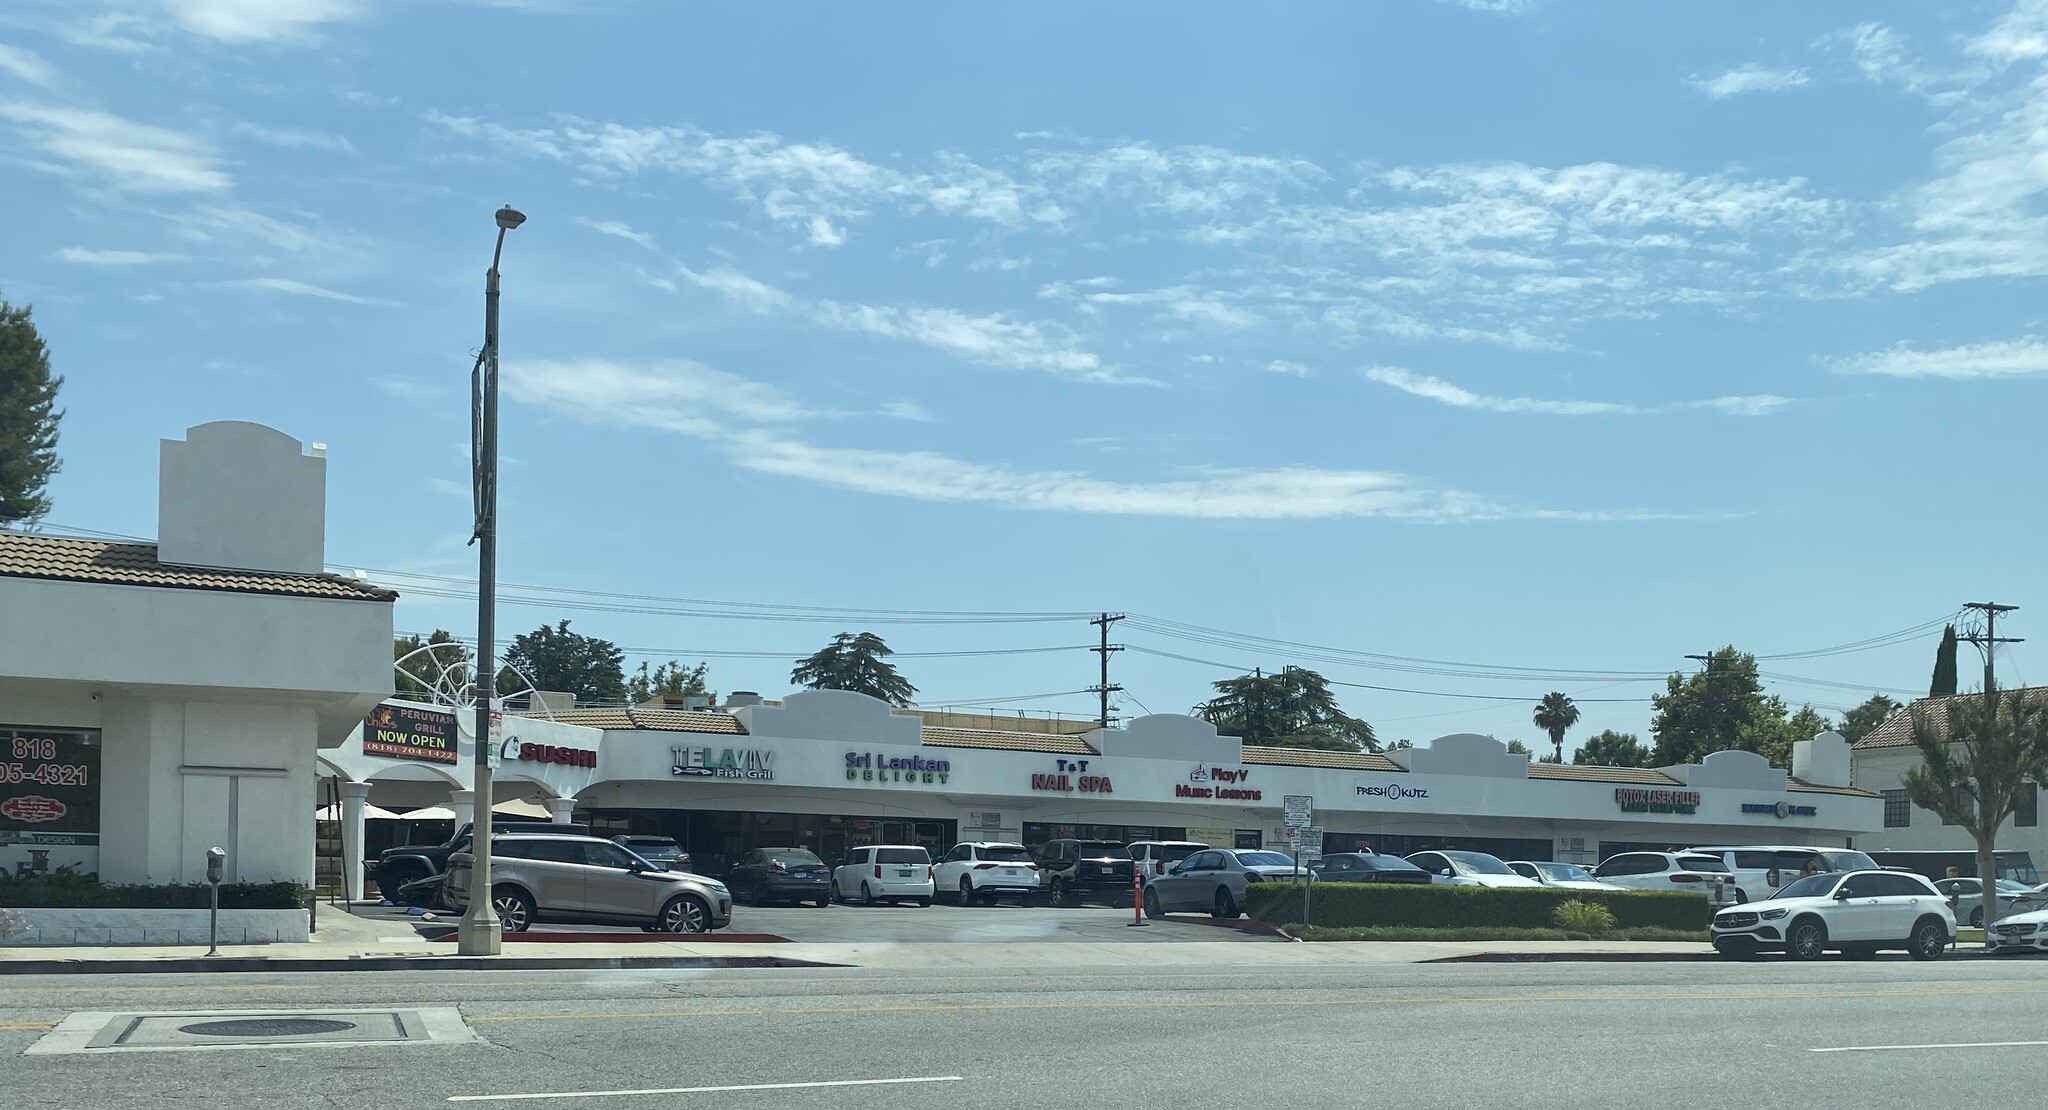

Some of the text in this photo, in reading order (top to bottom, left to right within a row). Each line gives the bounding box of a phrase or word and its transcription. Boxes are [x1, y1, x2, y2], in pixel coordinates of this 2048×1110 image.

[401, 709, 454, 724] PERUVIAN
[415, 723, 444, 735] GRILL
[377, 730, 445, 748] NOW OPEN
[13, 738, 55, 759] 818
[367, 743, 453, 759] (818) 704-1422
[519, 742, 597, 768] SUSHI
[845, 752, 950, 771] Sri Lankan
[716, 769, 775, 779] Fish Grill
[847, 769, 949, 784] DELIGHT
[1032, 774, 1113, 793] NAIL SPA
[1175, 784, 1262, 800] Music Lessons
[1356, 787, 1429, 798] FRESH KUTZ
[1615, 789, 1701, 806] BOTOX LASER FILLER
[37, 836, 76, 845] DESIGN
